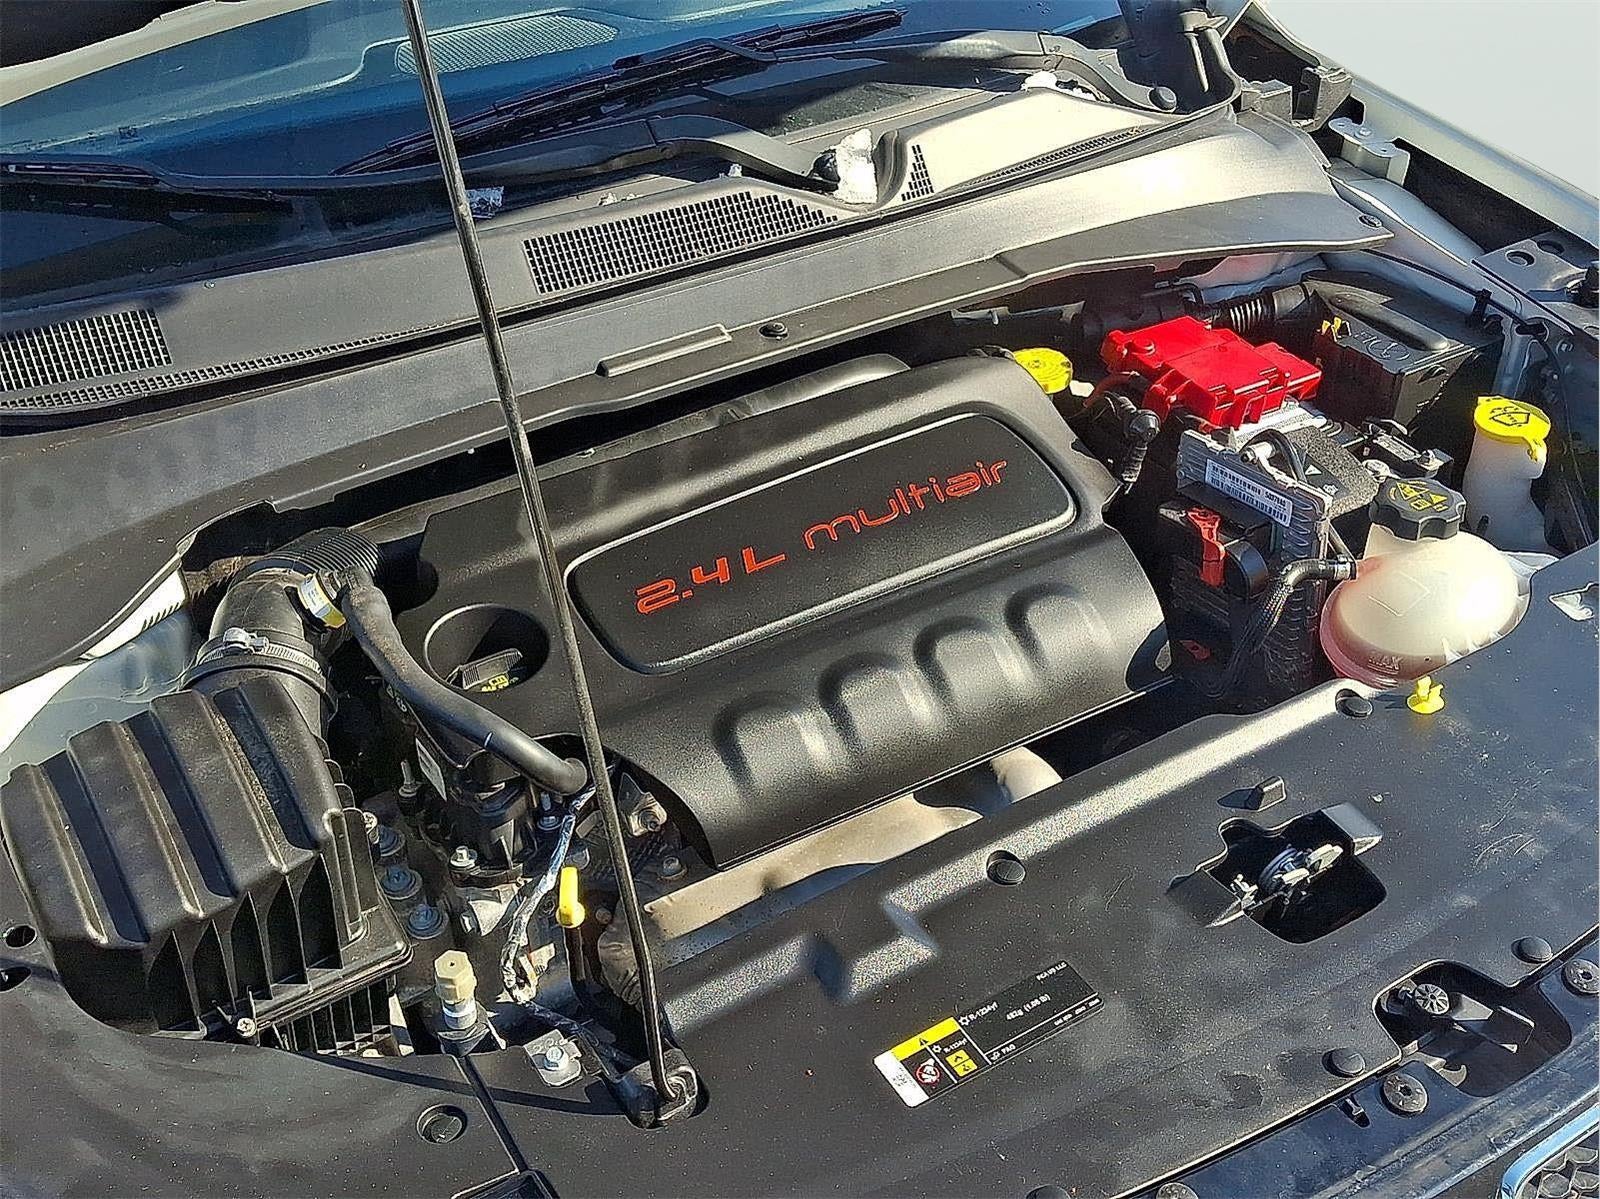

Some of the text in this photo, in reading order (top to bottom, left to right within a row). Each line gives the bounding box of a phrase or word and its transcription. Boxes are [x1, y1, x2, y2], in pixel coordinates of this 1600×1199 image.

[635, 459, 1008, 615] 2.4 L multiair
[968, 1002, 998, 1020] R-1234yf
